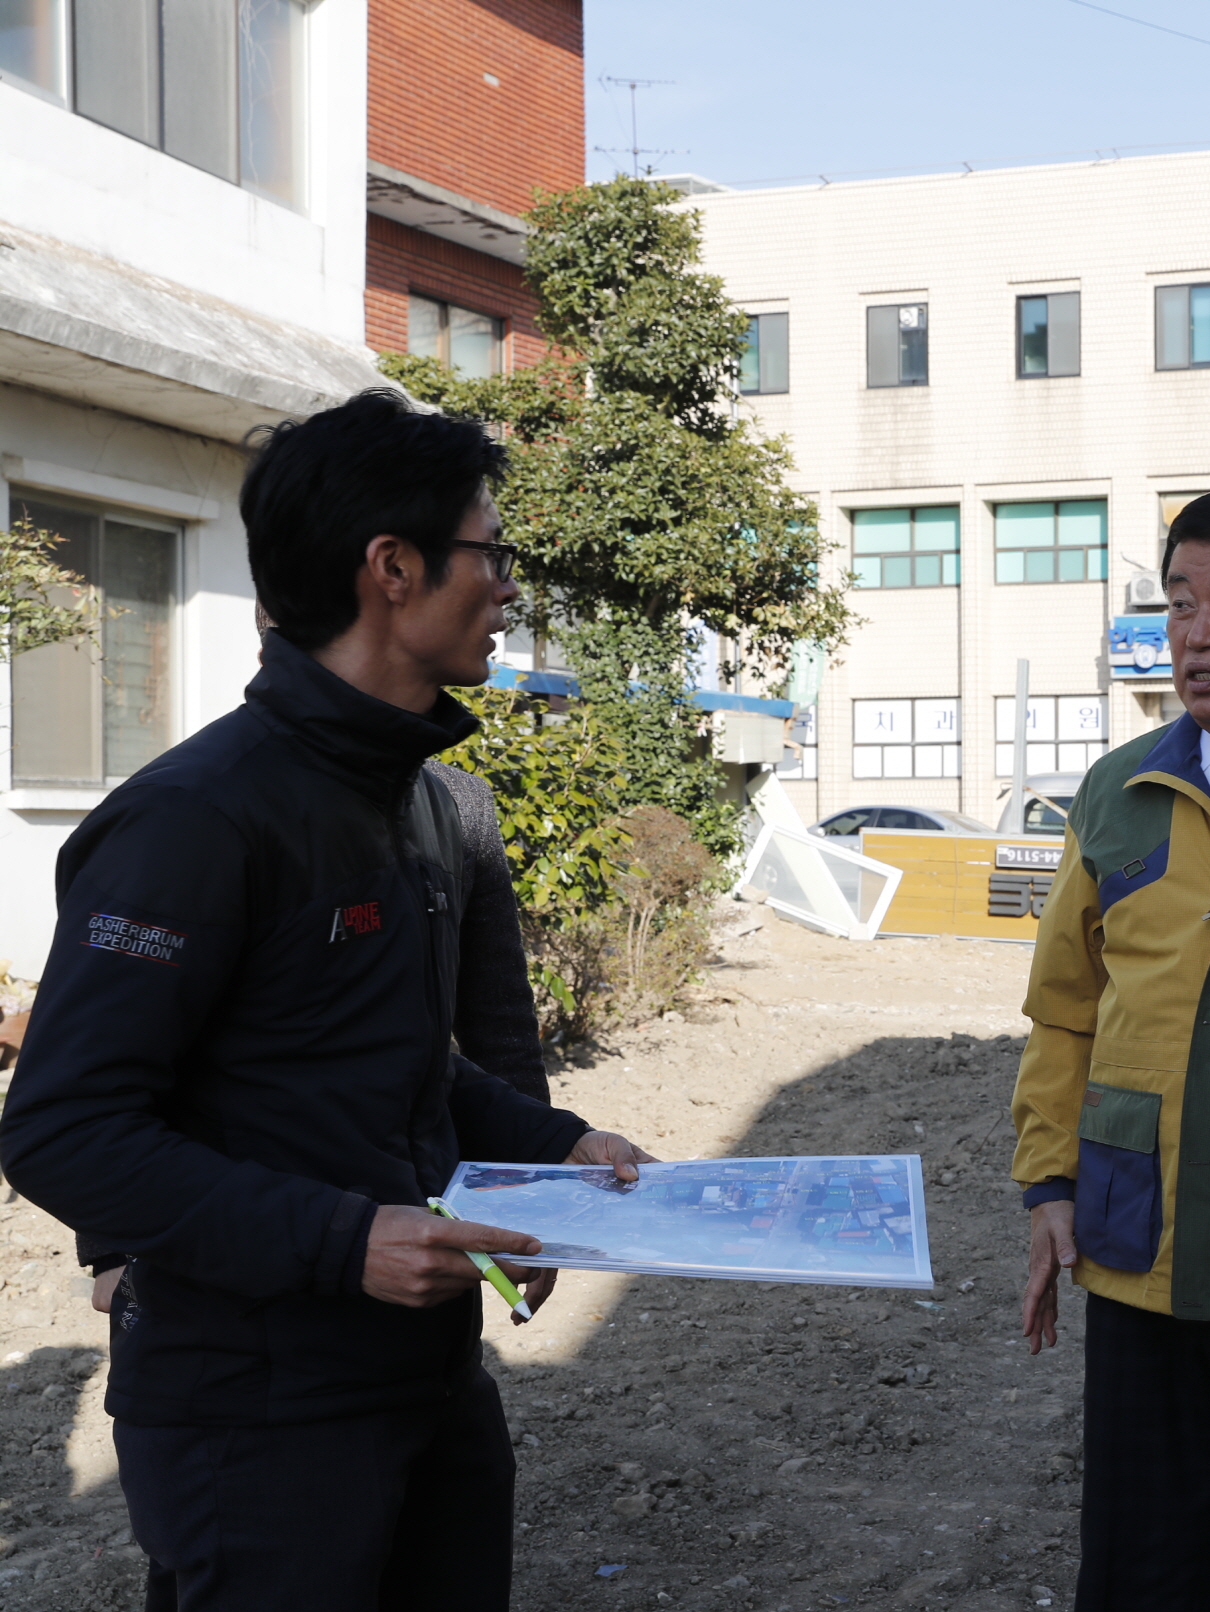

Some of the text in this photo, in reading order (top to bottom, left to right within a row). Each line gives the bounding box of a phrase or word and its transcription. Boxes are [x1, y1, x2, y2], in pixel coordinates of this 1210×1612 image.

[88, 916, 185, 949] GASHERBRUM
[328, 902, 380, 944] ALPINE
[355, 917, 382, 935] TEAM
[89, 930, 173, 961] EXPEDITION
